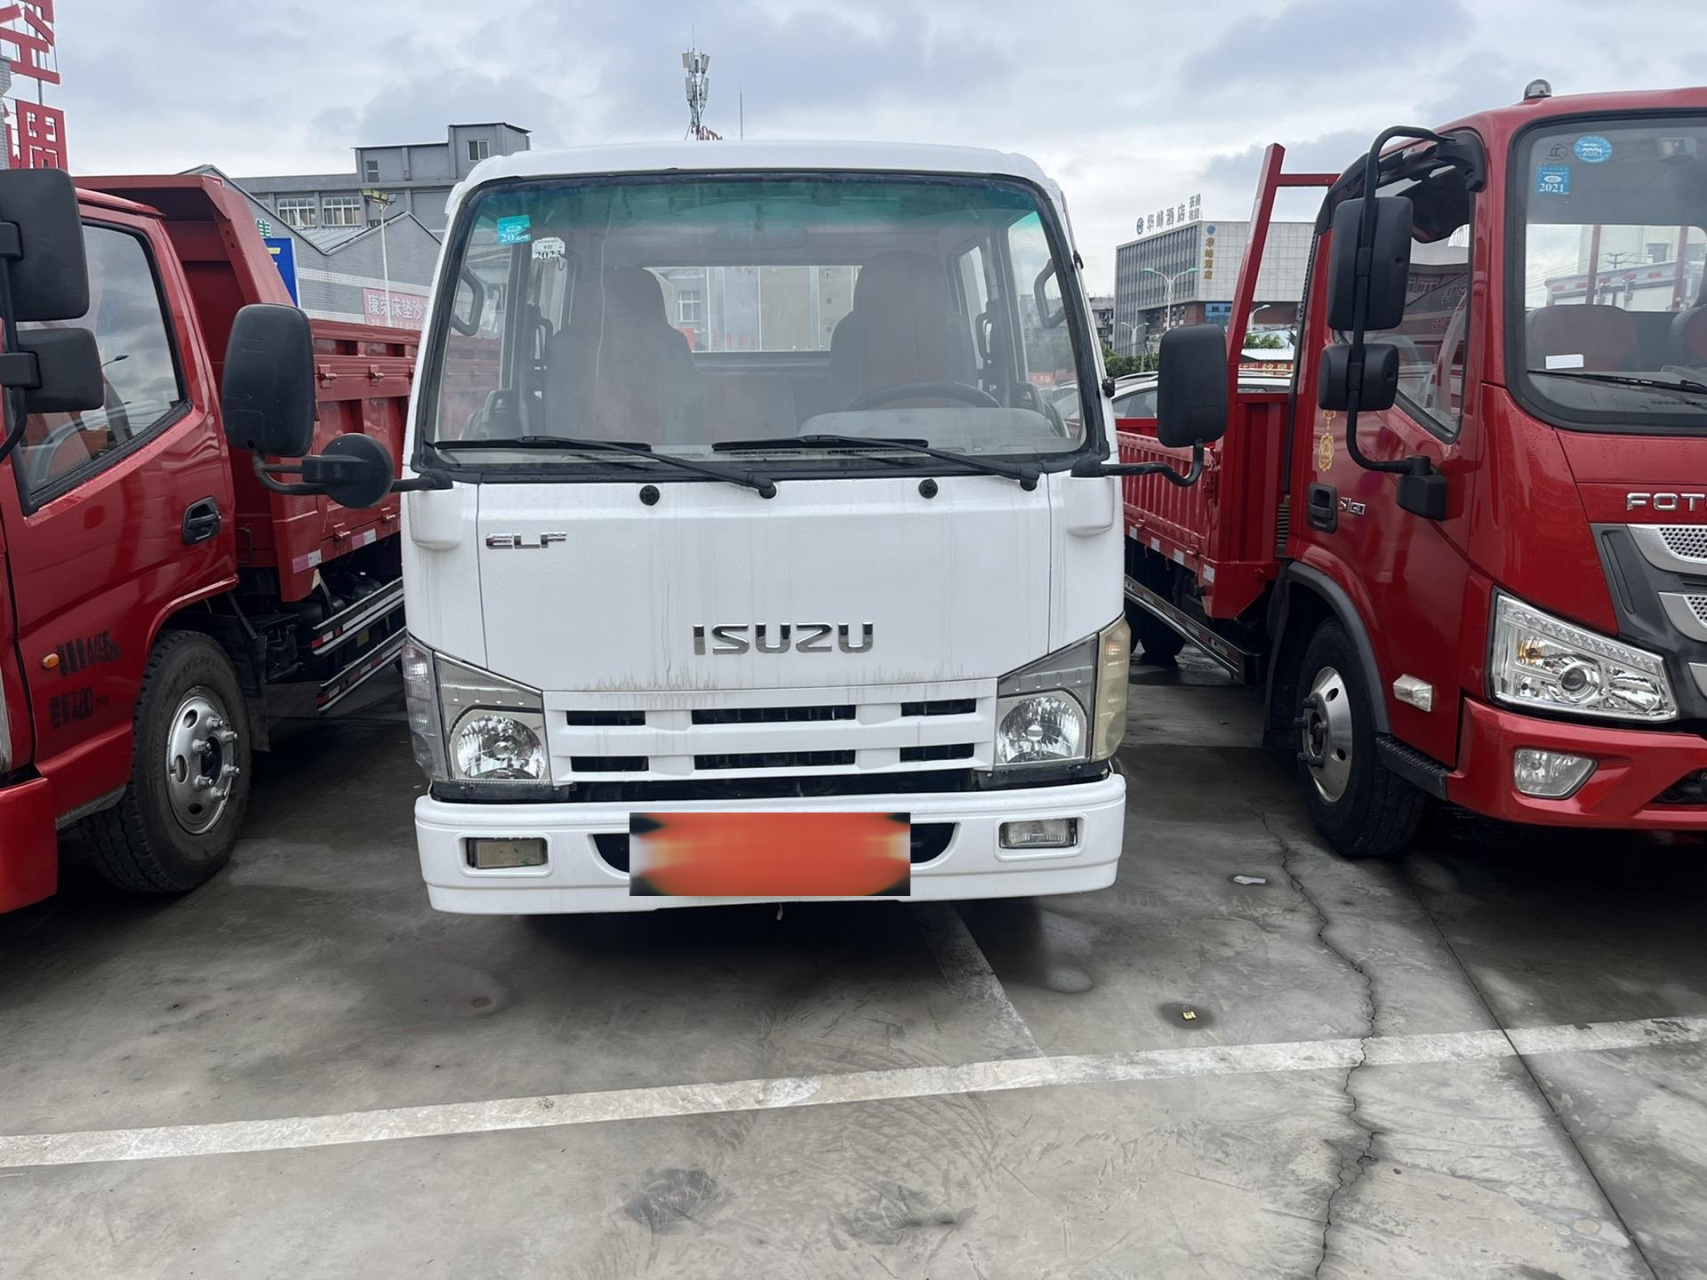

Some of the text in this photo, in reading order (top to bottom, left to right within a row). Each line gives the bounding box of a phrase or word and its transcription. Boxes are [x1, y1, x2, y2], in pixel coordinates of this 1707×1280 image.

[1582, 147, 1603, 157] 2021
[1539, 183, 1564, 193] 2021
[1626, 492, 1707, 511] FOT
[486, 531, 567, 550] ELF
[693, 621, 874, 656] ISUZU
